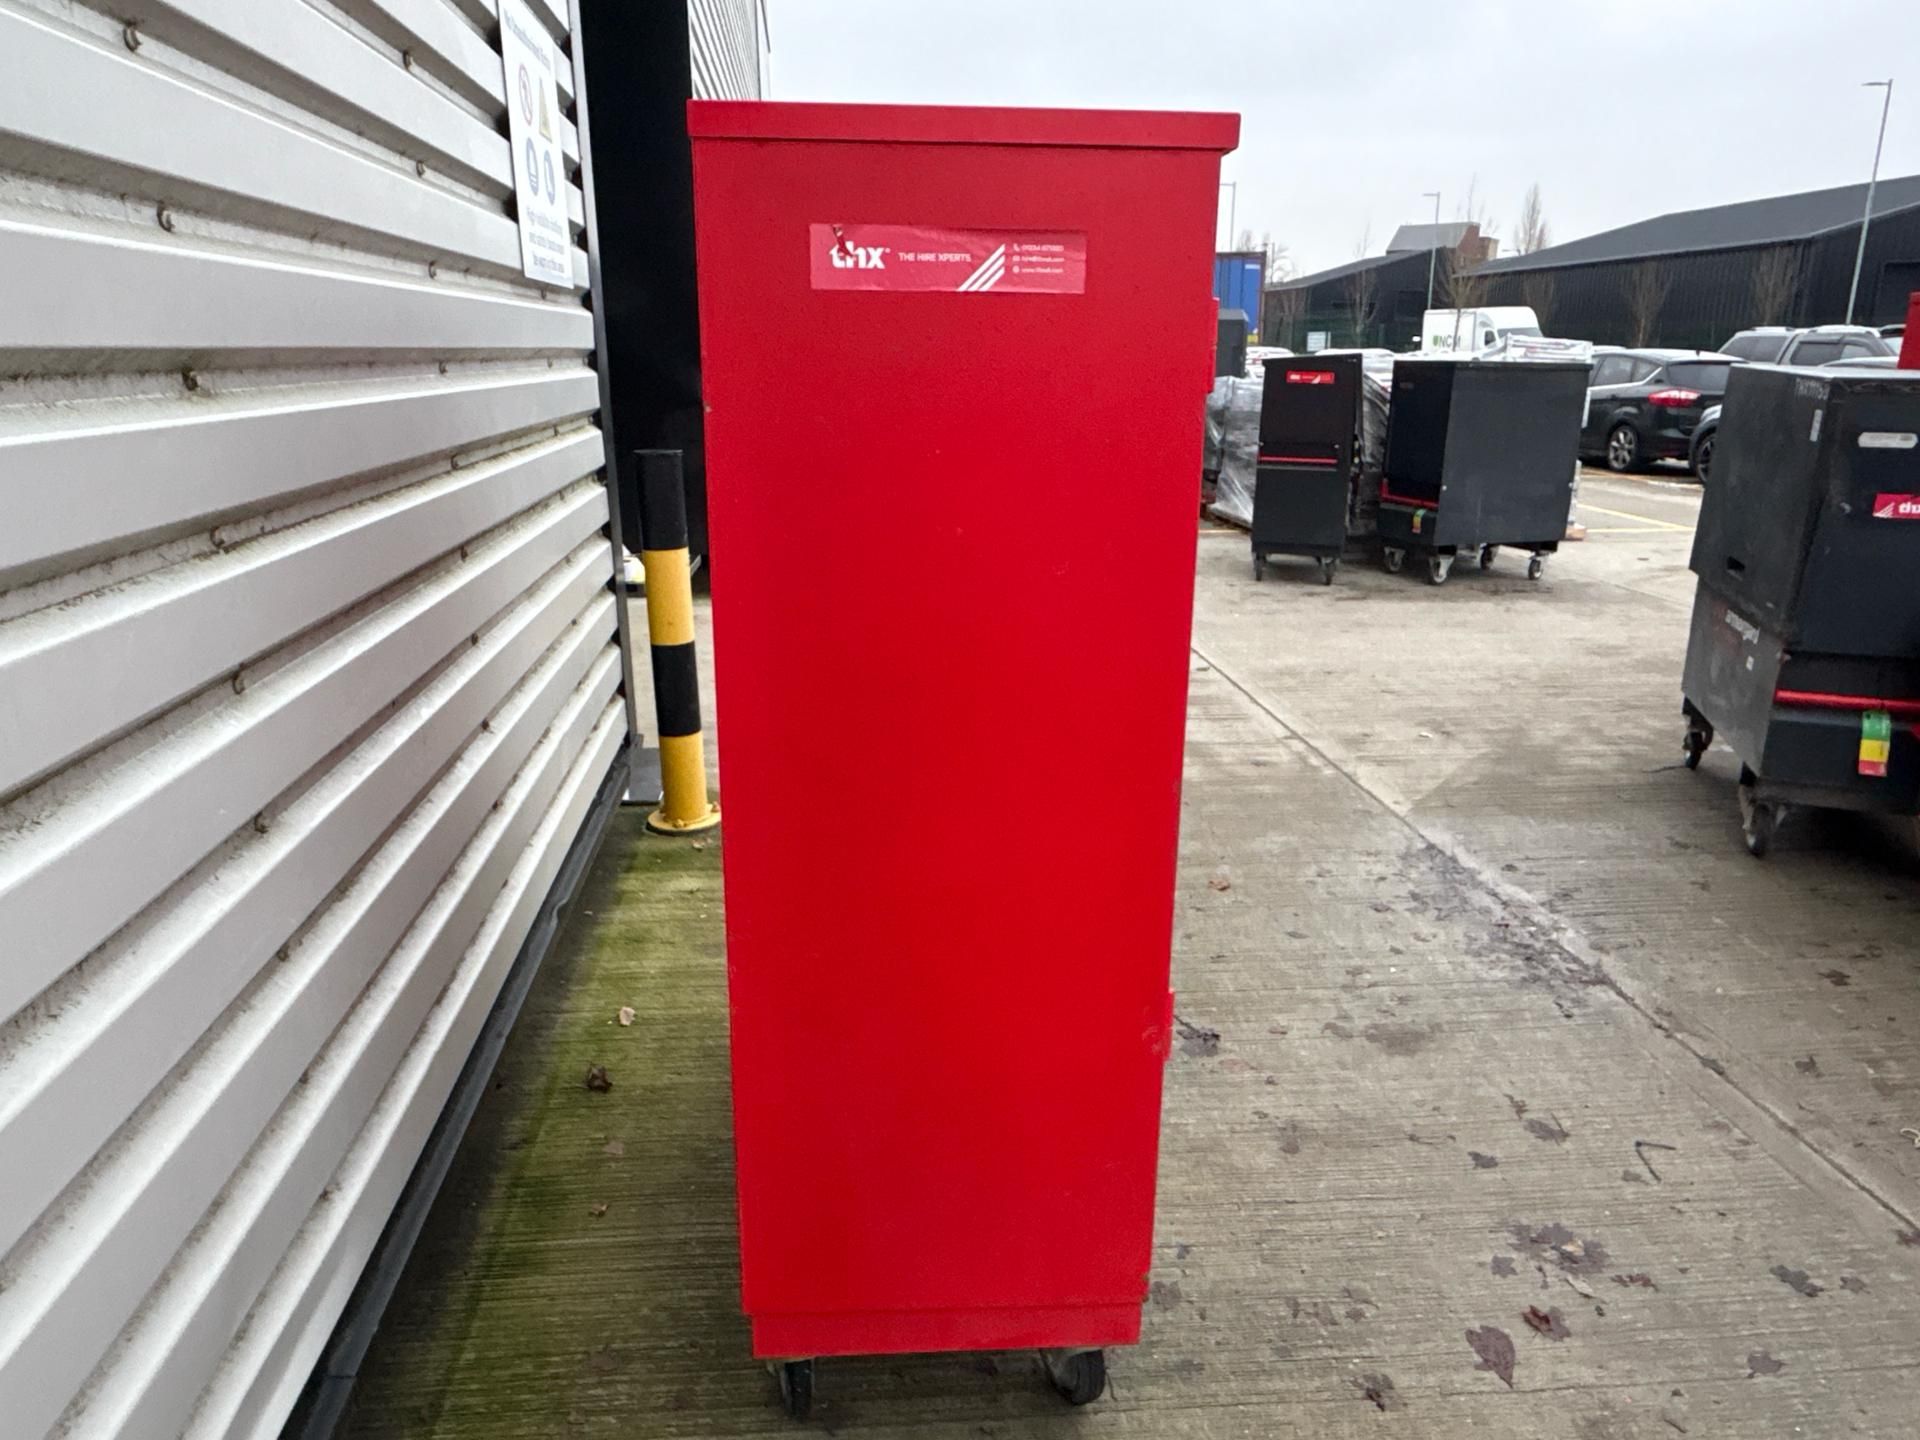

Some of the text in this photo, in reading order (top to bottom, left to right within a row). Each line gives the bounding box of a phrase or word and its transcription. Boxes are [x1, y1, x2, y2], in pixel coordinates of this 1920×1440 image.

[898, 252, 972, 263] THE HIRE XPERTS
